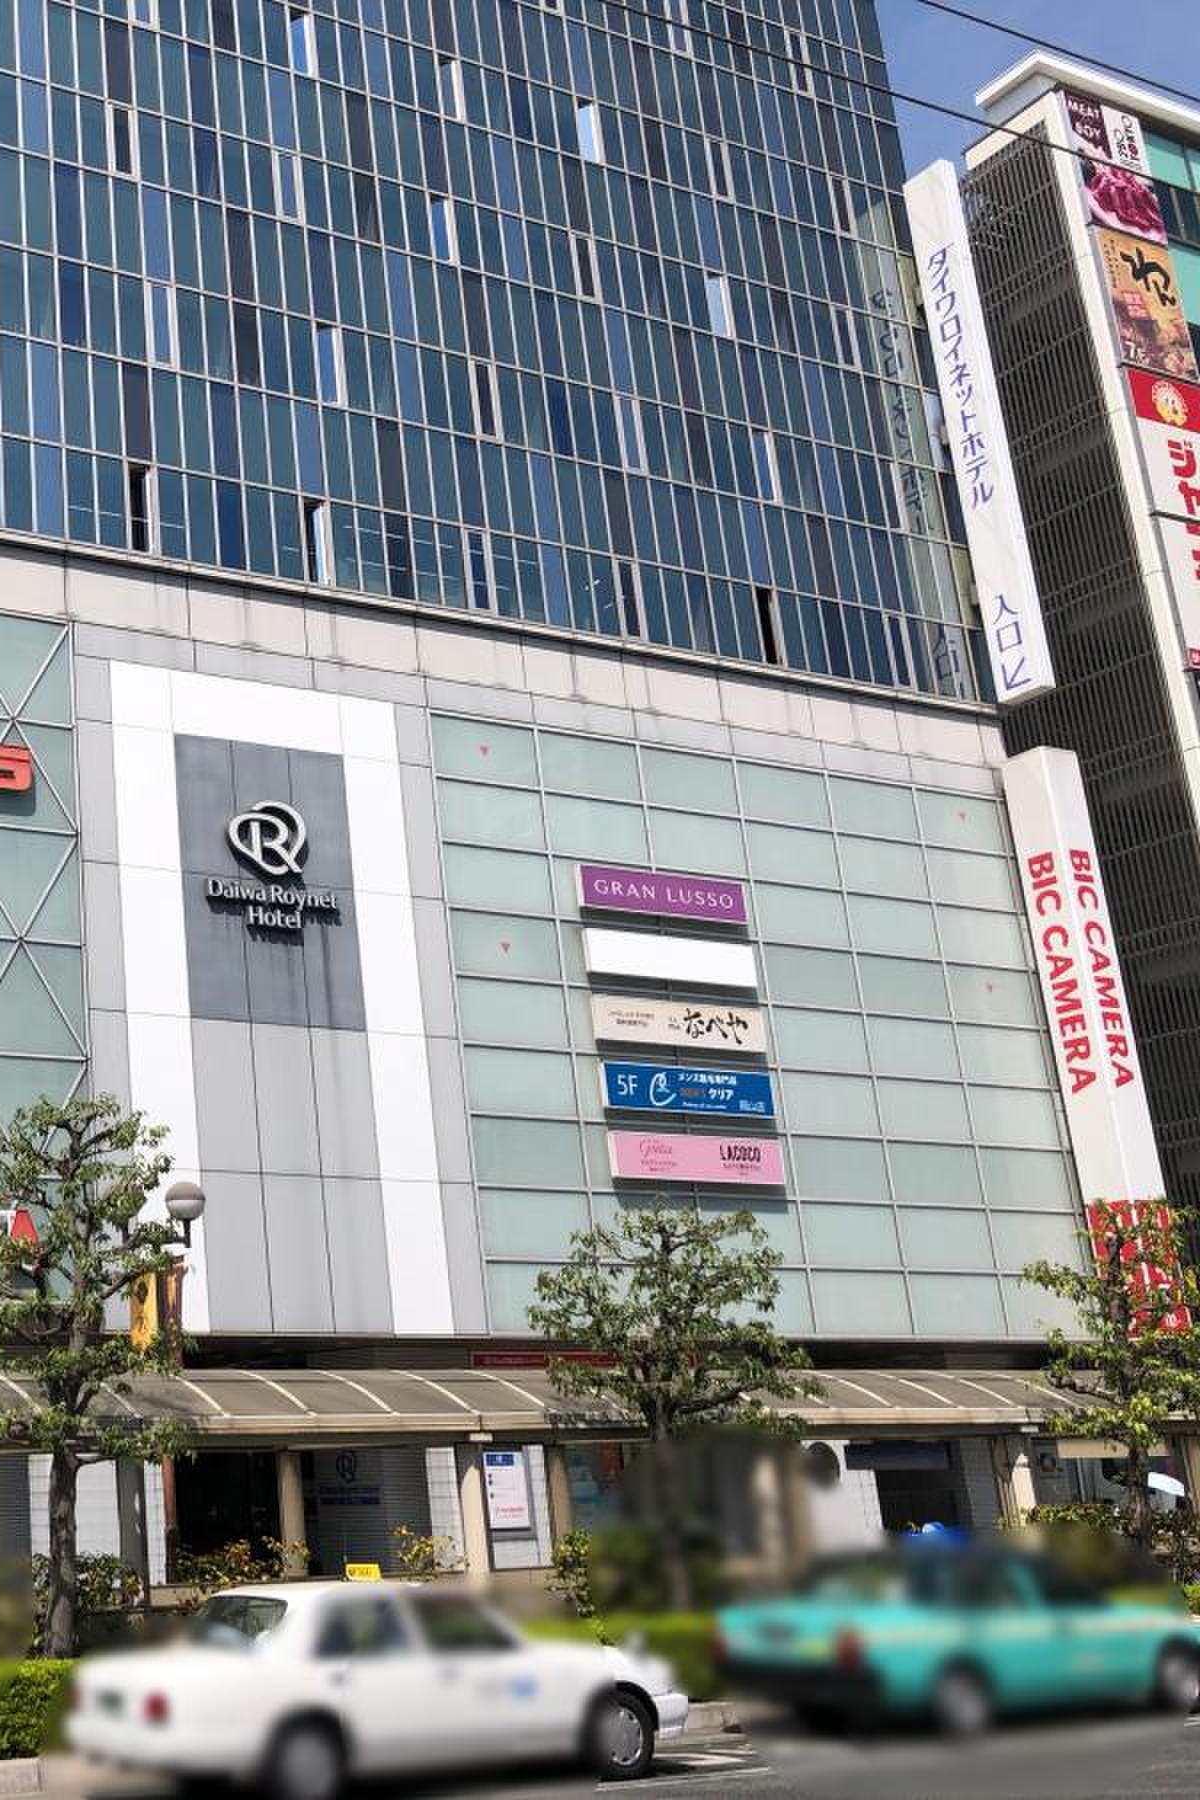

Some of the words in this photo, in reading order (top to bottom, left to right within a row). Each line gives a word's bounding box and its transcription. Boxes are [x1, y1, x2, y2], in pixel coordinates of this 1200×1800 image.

[928, 242, 993, 508] ダイワロイネットホテル
[993, 594, 1022, 653] 入口
[208, 879, 266, 901] Daiwa
[271, 884, 337, 910] Roynet
[592, 878, 657, 901] GRAN
[665, 886, 734, 909] LUSSO
[1028, 851, 1061, 916] BIC
[248, 905, 302, 929] Hotel
[1069, 849, 1099, 910] BIC
[1084, 920, 1134, 1089] CAMERA
[684, 1007, 749, 1045] なべや
[1042, 925, 1097, 1095] CAMERA
[617, 1074, 639, 1096] 5F
